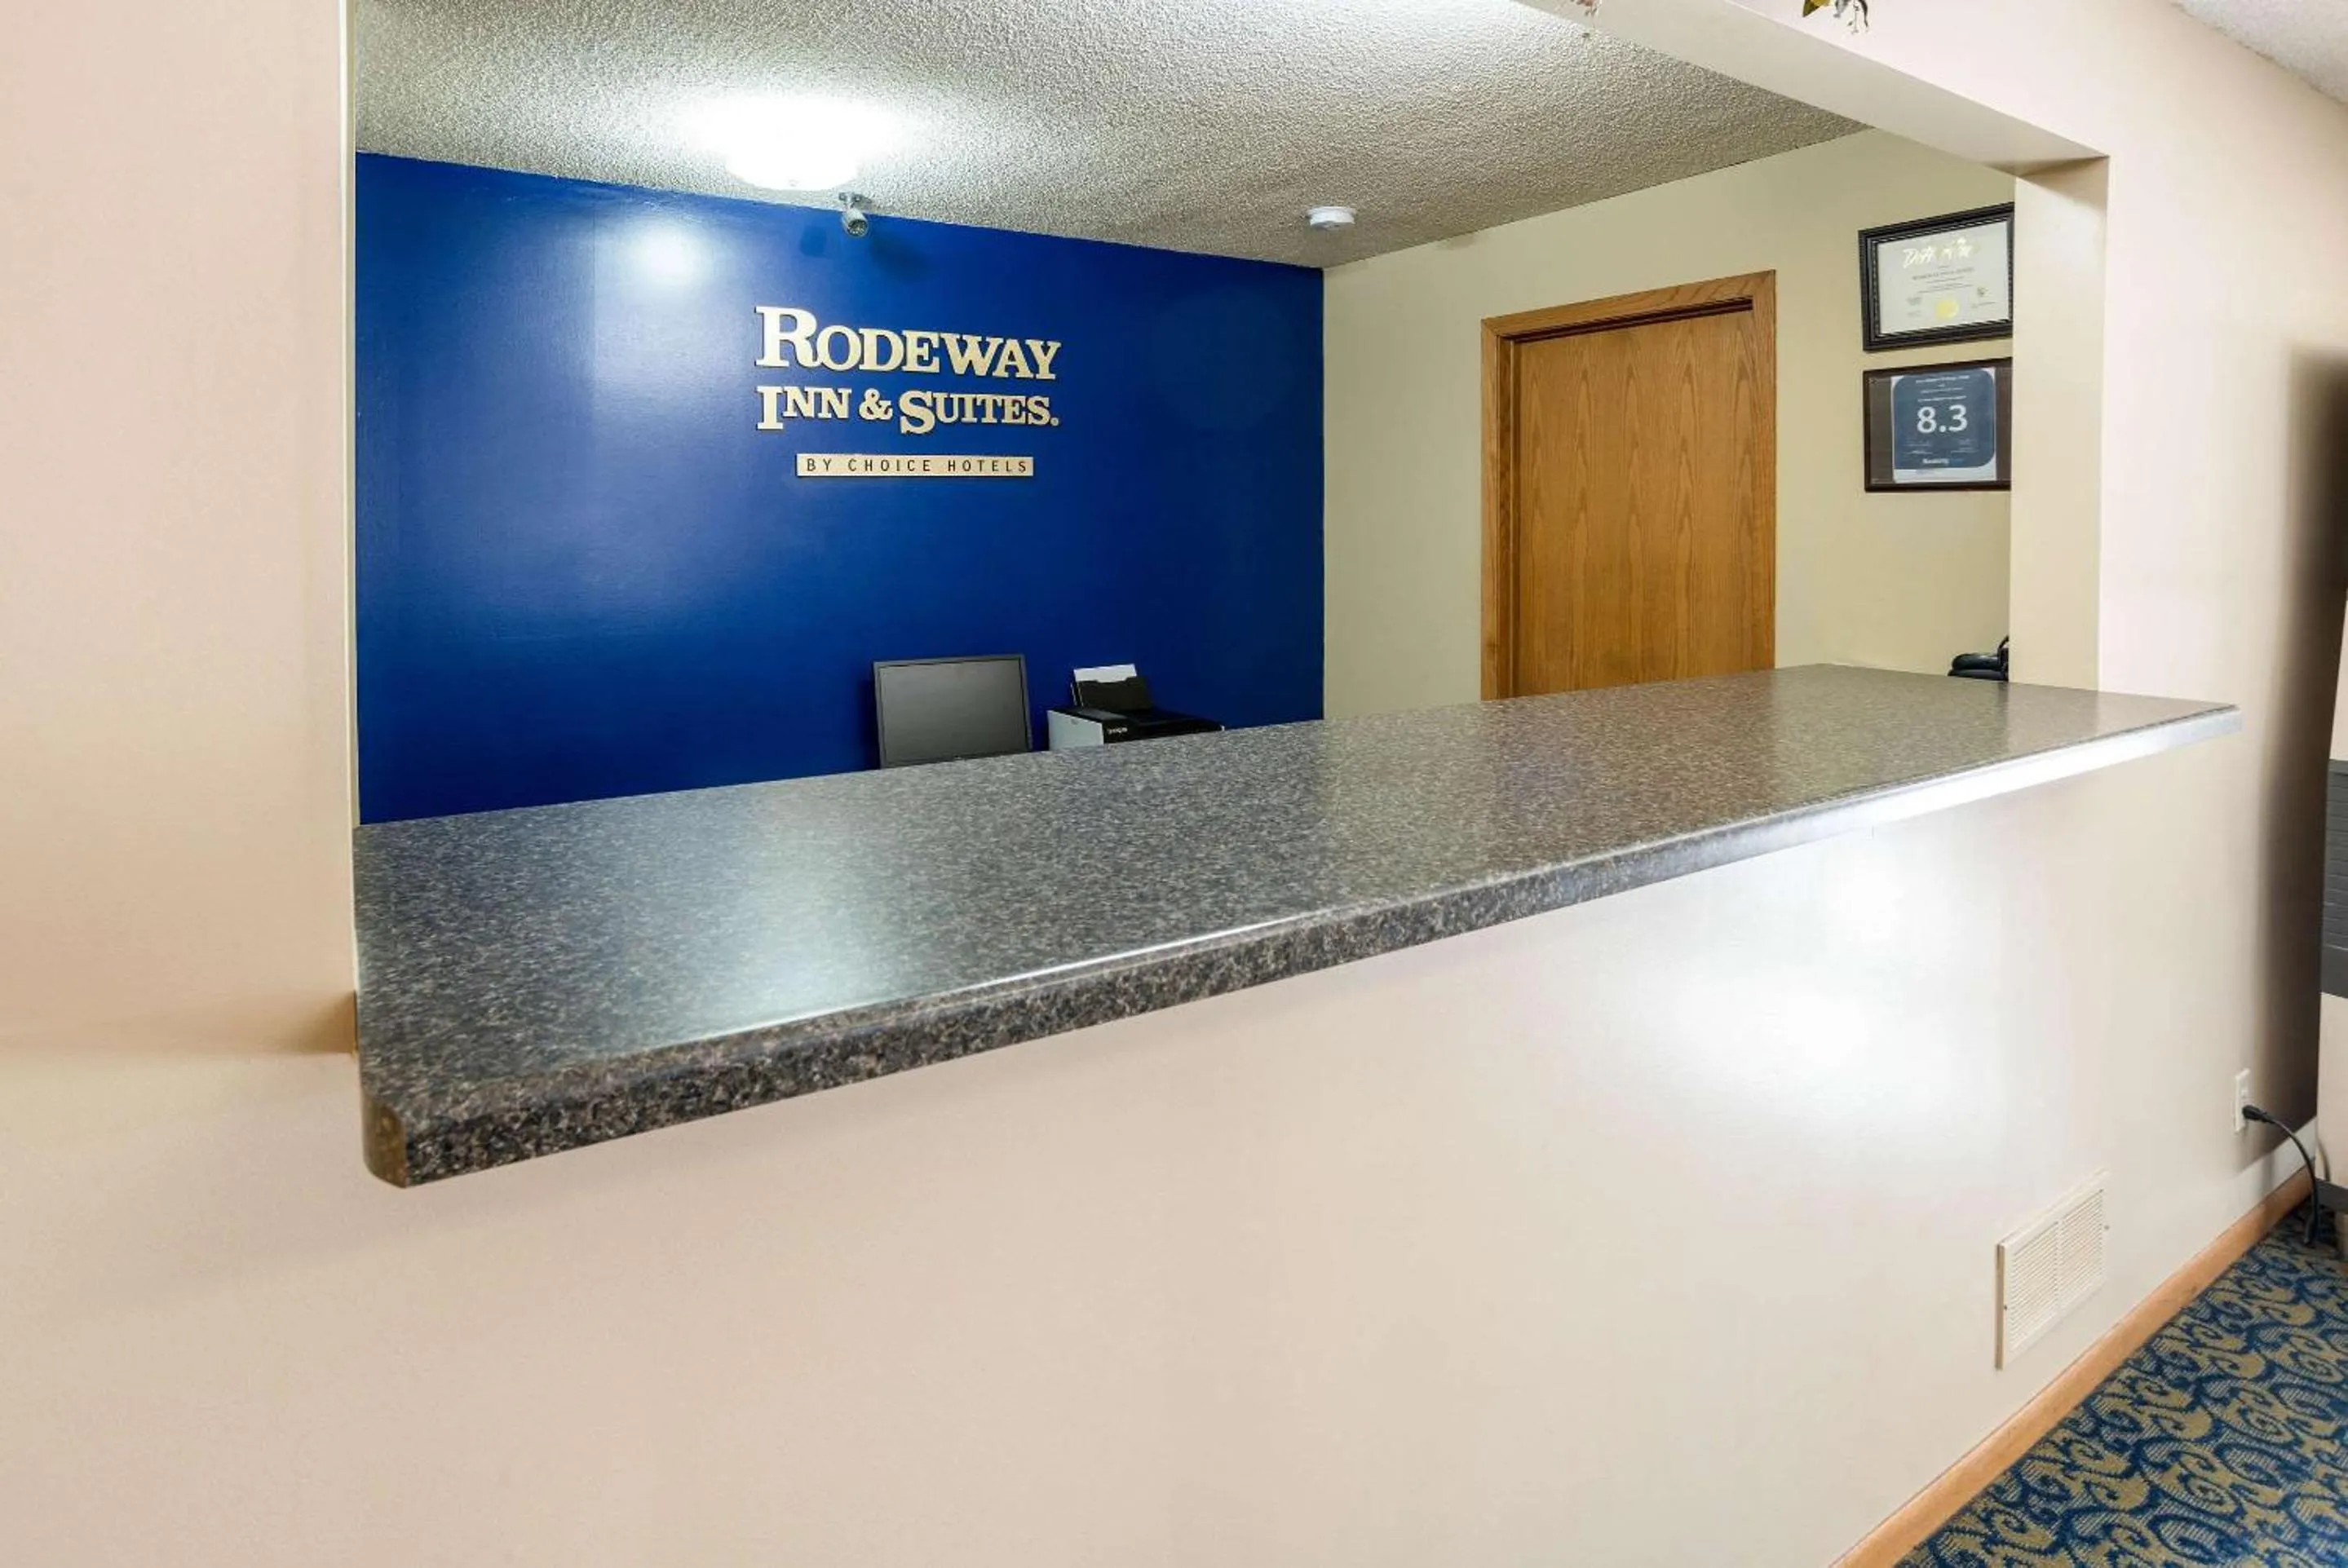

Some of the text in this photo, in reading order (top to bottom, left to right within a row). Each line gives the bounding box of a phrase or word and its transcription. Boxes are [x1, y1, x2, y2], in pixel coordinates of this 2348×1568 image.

[755, 306, 1060, 380] RODEWAY
[756, 386, 852, 430] INN
[859, 387, 893, 420] &
[1917, 404, 1968, 434] 8.3
[806, 458, 1027, 473] BY CHOICE HOTELS
